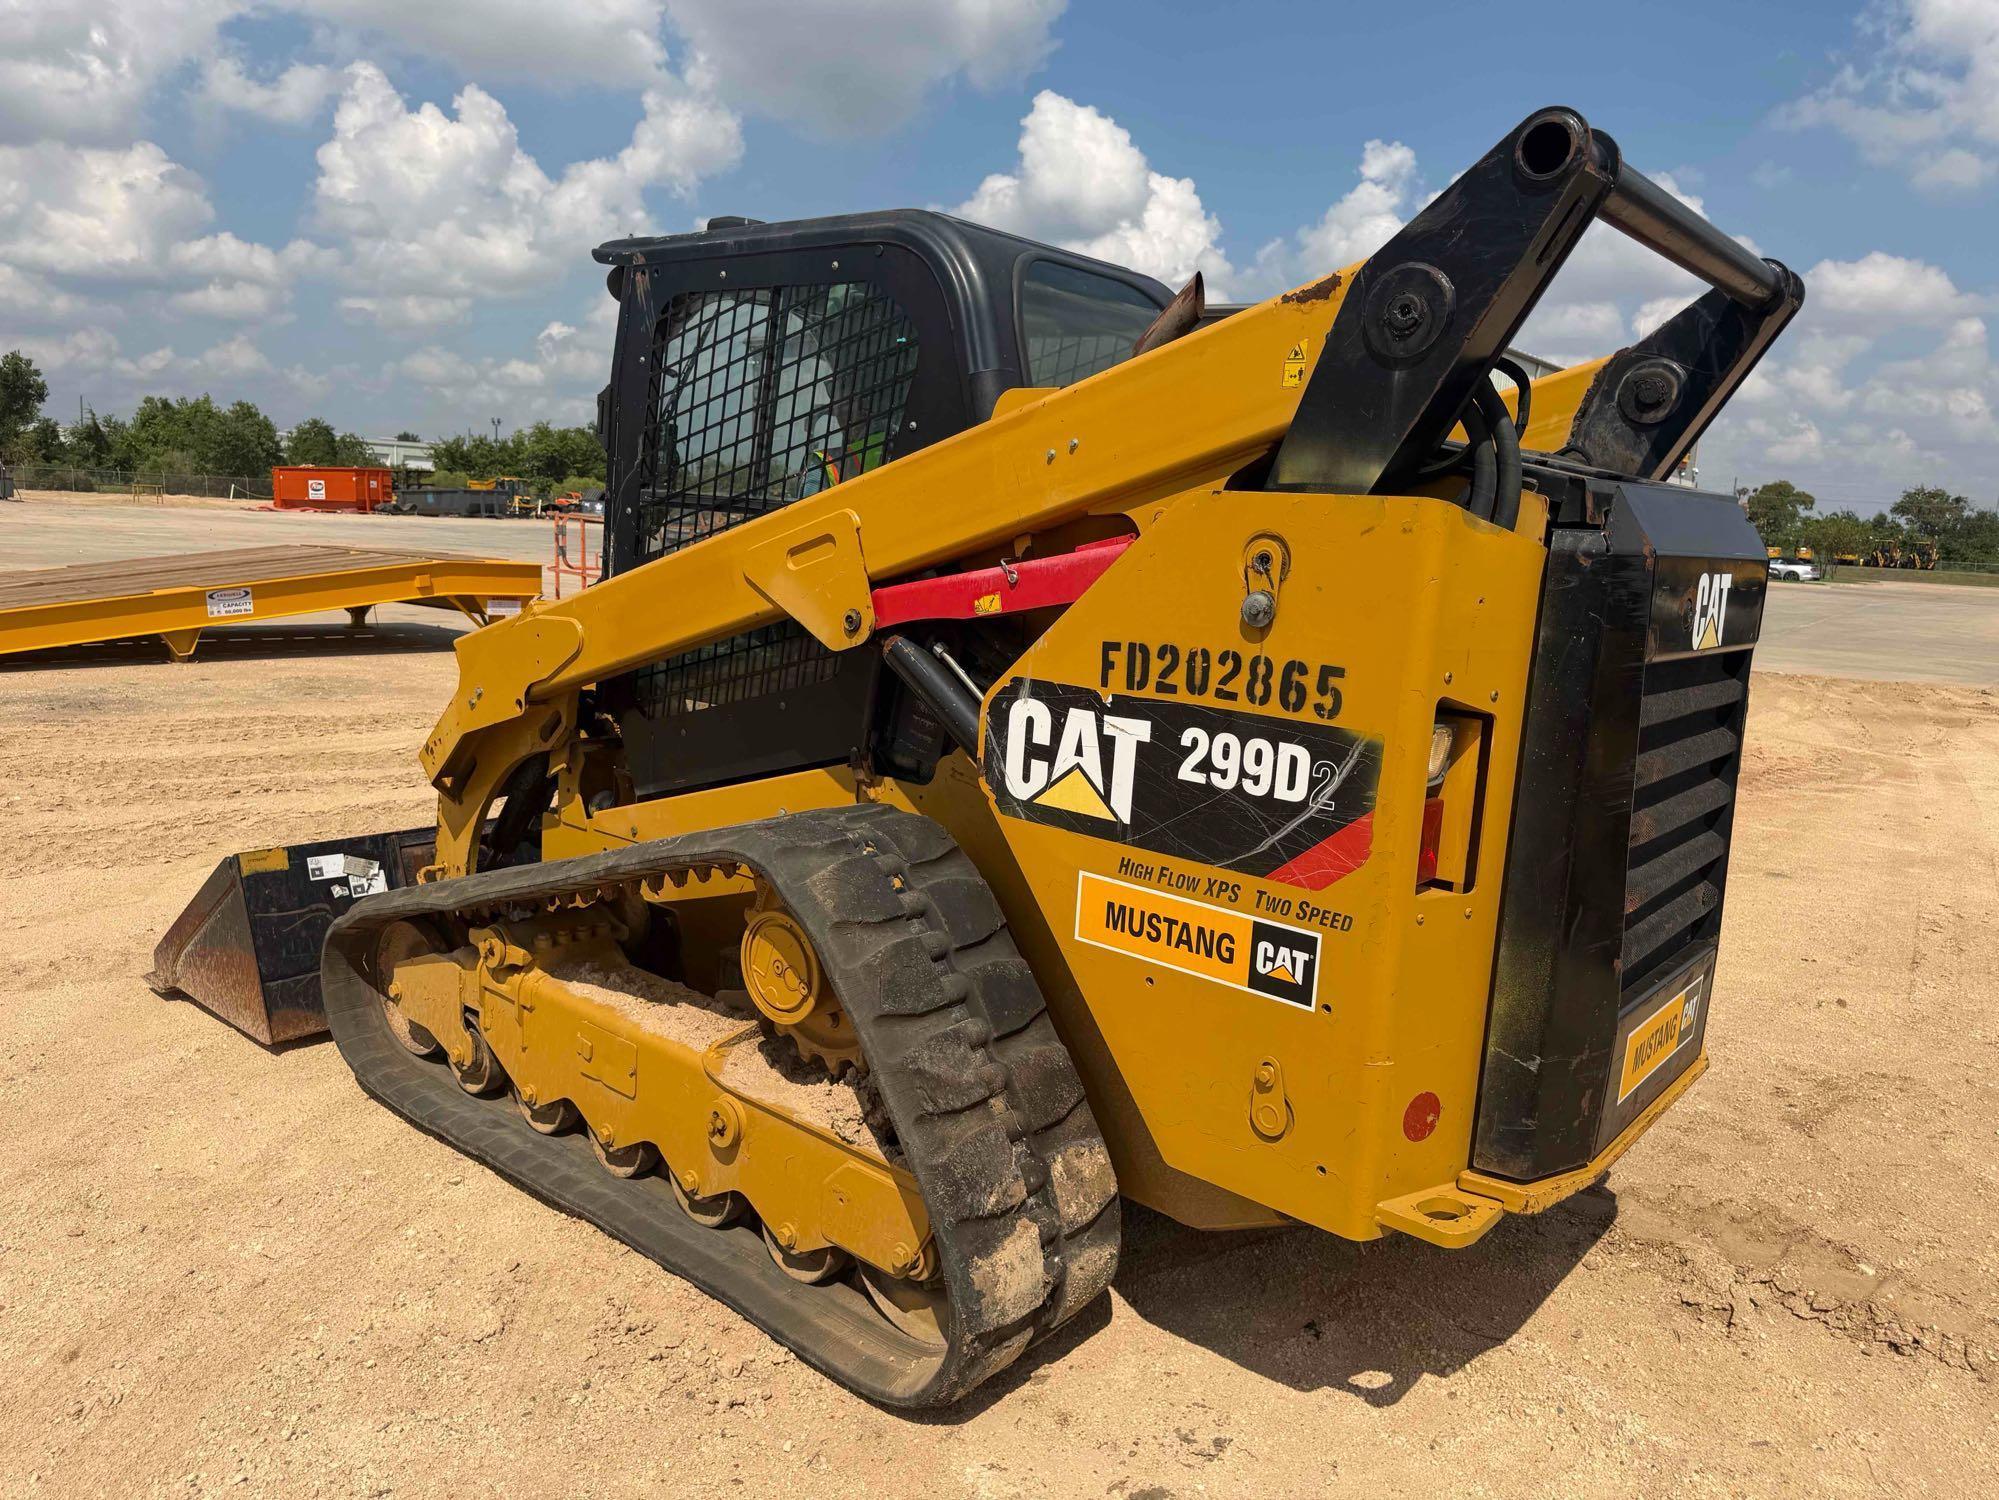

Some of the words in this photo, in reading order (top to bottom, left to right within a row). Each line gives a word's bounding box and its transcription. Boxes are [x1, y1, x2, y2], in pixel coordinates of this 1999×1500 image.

[1692, 572, 1733, 651] CAT
[1101, 641, 1346, 720] FD202865
[1005, 697, 1152, 825] CAT
[1203, 877, 1242, 903] XPS
[1105, 901, 1236, 964] MUSTANG
[1256, 940, 1310, 986] CAT
[1631, 1013, 1678, 1075] MUSTANG
[1681, 995, 1699, 1031] CAT
